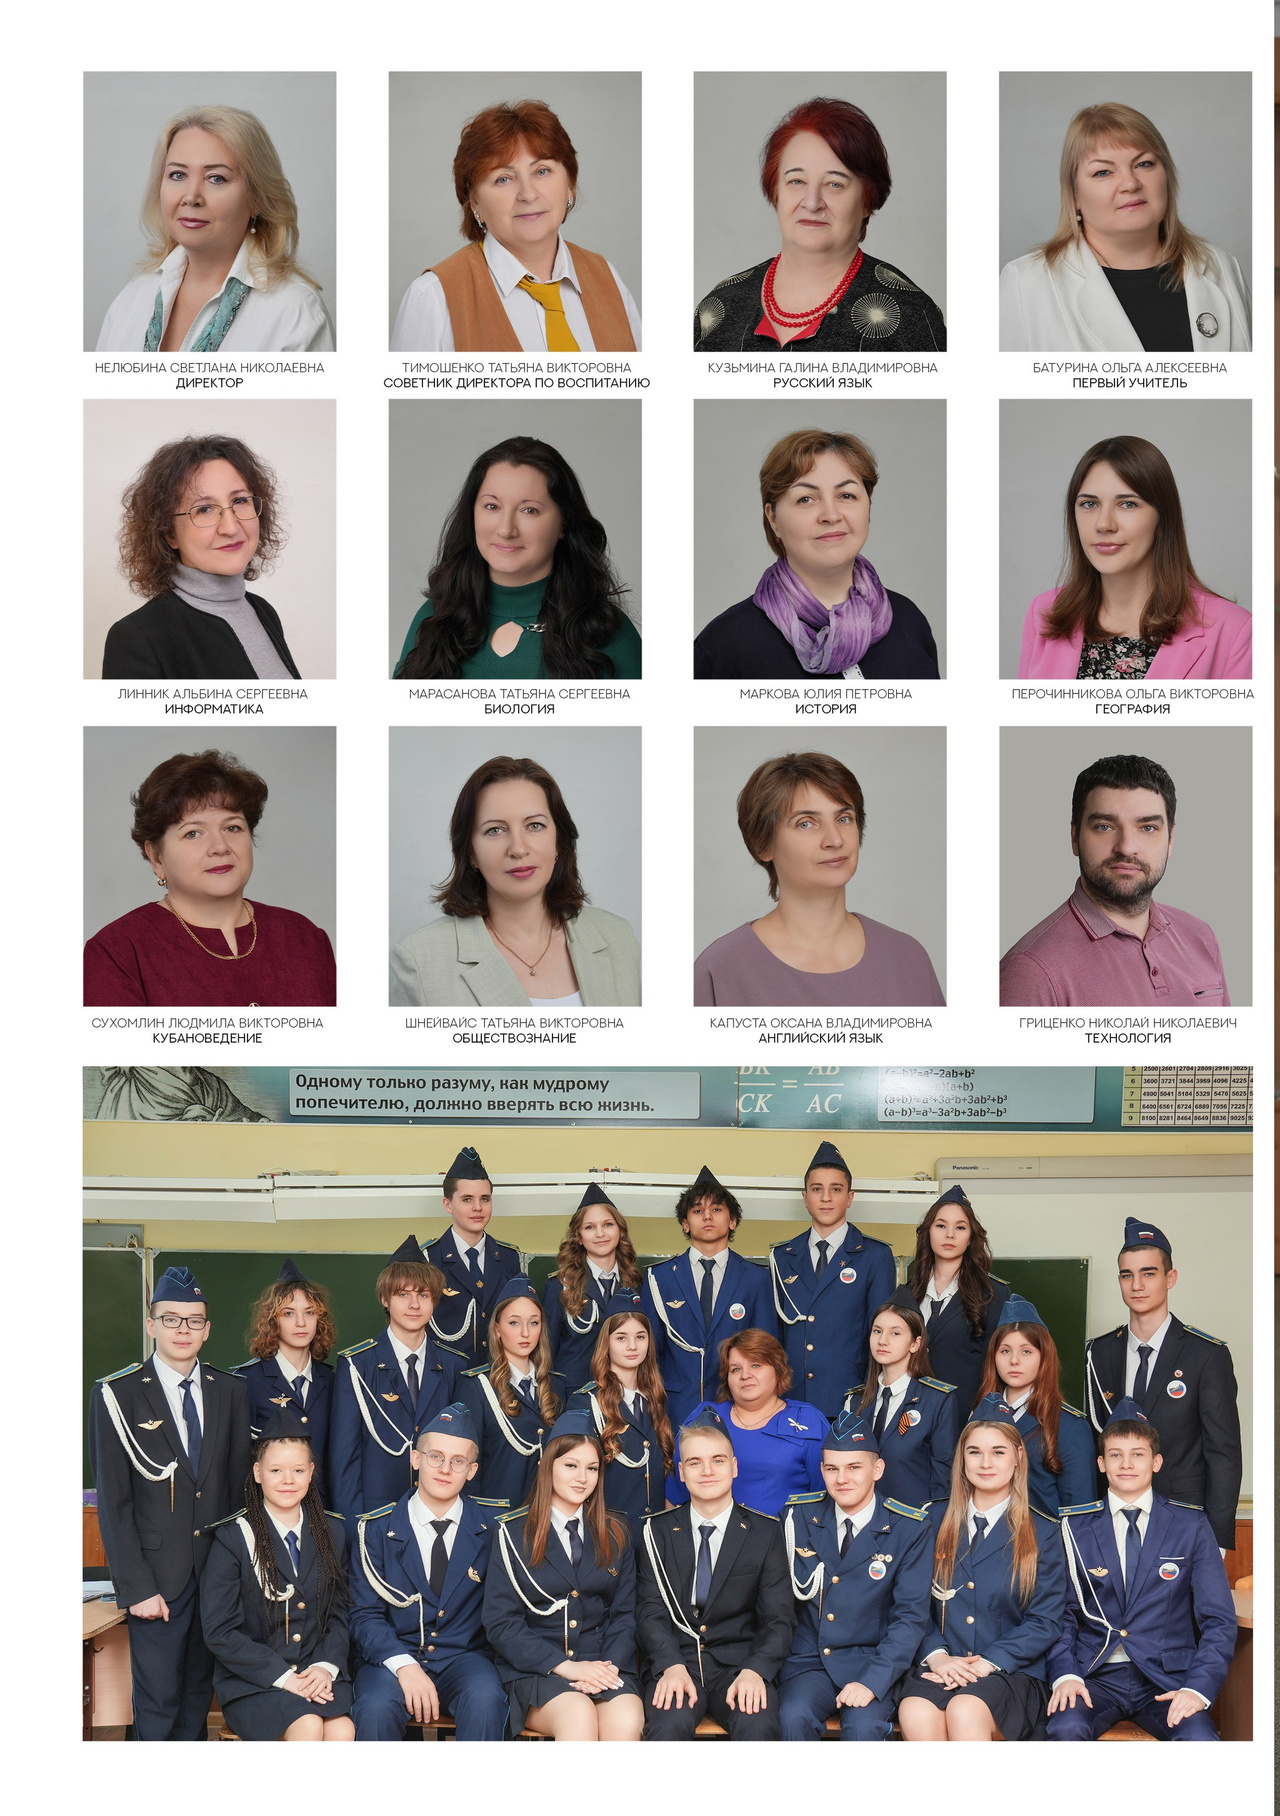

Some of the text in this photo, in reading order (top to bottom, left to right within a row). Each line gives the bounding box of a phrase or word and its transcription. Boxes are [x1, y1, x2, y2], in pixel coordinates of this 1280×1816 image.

[295, 1073, 610, 1093] Одному только разуму, как мудрому
[295, 1097, 655, 1114] попечителю, должно вверять всю жизнь.
[735, 1093, 773, 1113] CK
[805, 1093, 842, 1114] AC
